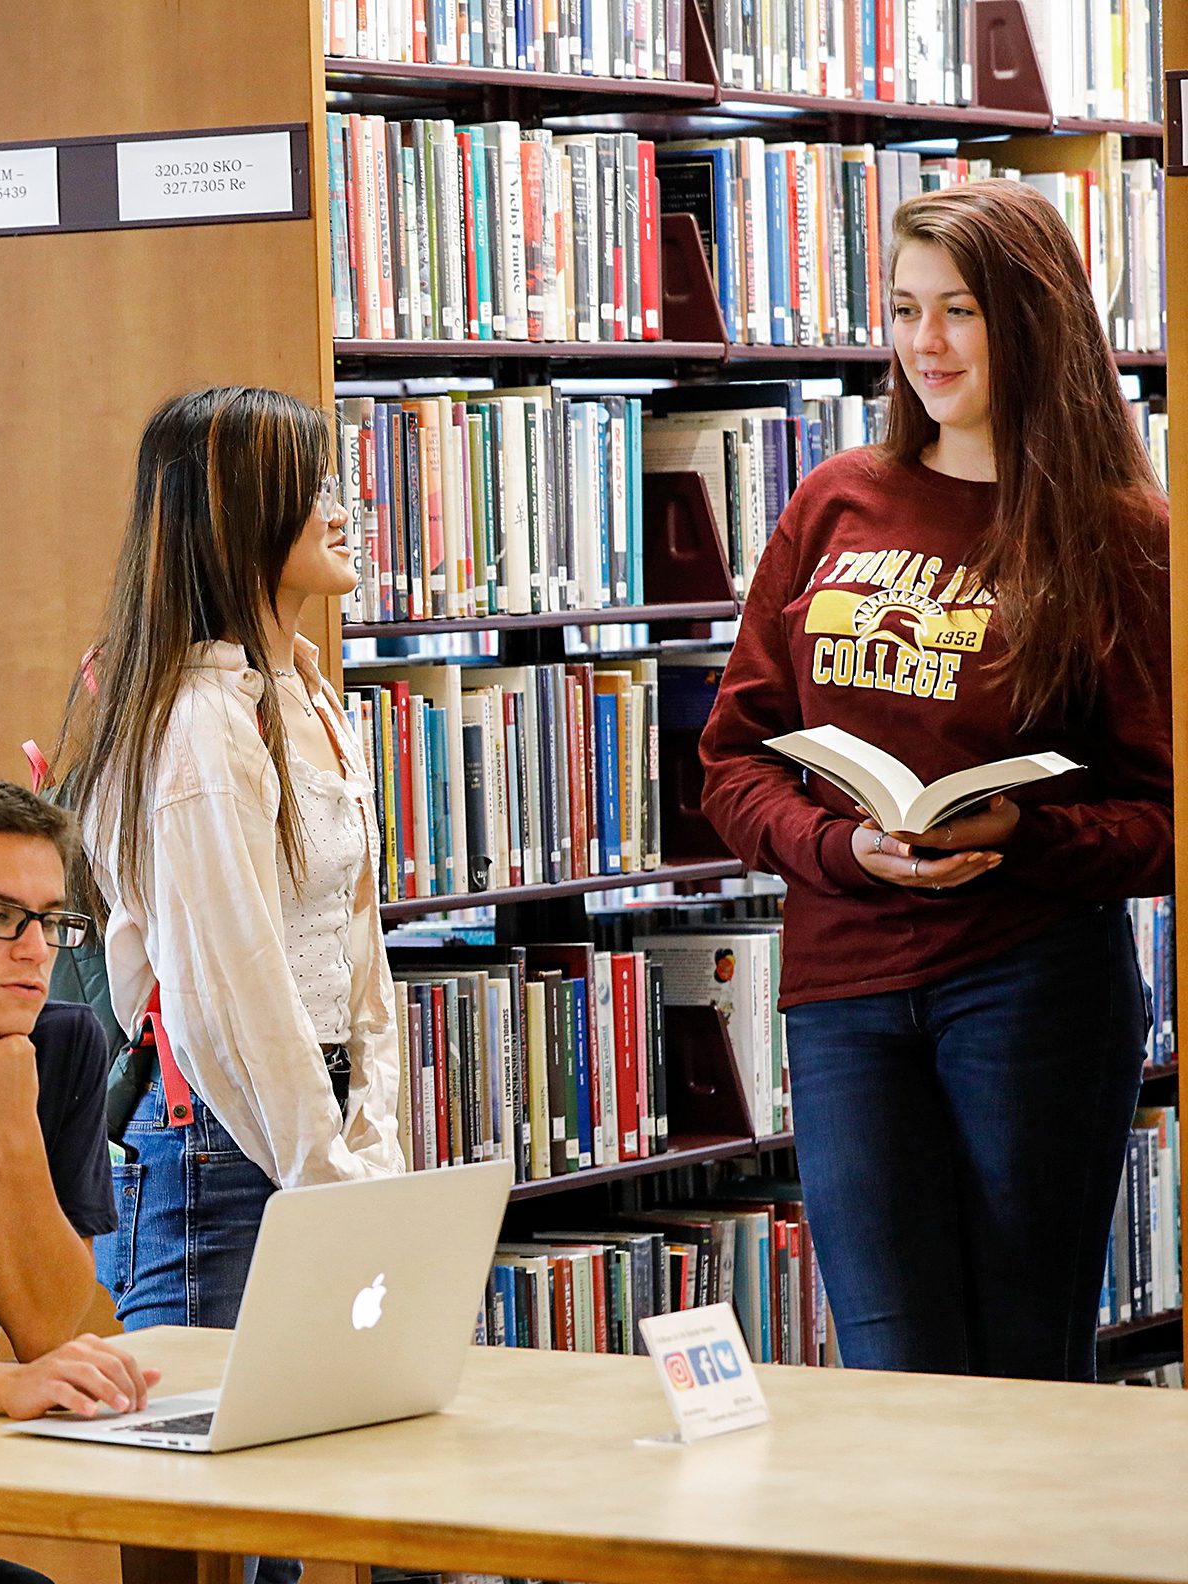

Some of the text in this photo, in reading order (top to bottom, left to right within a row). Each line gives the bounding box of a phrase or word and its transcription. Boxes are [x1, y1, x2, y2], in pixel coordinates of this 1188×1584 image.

[154, 161, 209, 178] 320.520
[212, 159, 243, 174] SKO
[162, 177, 247, 196] 327.7305 Re
[396, 172, 404, 195] Beer
[376, 153, 390, 278] ANARCHIST VOICES
[476, 199, 485, 247] IRELAND
[509, 179, 522, 294] Vichy France
[795, 165, 810, 275] MIDNIGHT
[398, 213, 407, 266] Revolution
[745, 199, 756, 312] OF LONG MEMORY
[631, 242, 640, 285] Monarchy
[408, 416, 417, 449] INDIA
[530, 427, 538, 463] KENYA'S
[350, 436, 362, 487] MAO
[352, 496, 362, 524] TSE
[546, 482, 555, 535] RHETORIC
[532, 515, 540, 568] DEMOCRACY
[821, 549, 943, 596] THOMAS
[935, 631, 977, 647] 1952
[812, 637, 962, 701] COLLEGE
[416, 704, 425, 766] of Imperialism
[649, 725, 658, 780] FASCISM
[495, 743, 504, 816] DEMOCRACY
[588, 724, 598, 825] Godly Republicanism
[502, 1008, 510, 1043] SCHOOLS
[503, 1045, 510, 1053] OF
[401, 1004, 412, 1136] THE ENGLISH REVOLUTION
[473, 1069, 482, 1102] Ethiopia
[513, 1082, 520, 1094] IN
[520, 1047, 528, 1105] Encyclopedia
[423, 1081, 431, 1117] WHITE
[513, 1095, 521, 1125] CHINA
[564, 1283, 572, 1327] SELMA
